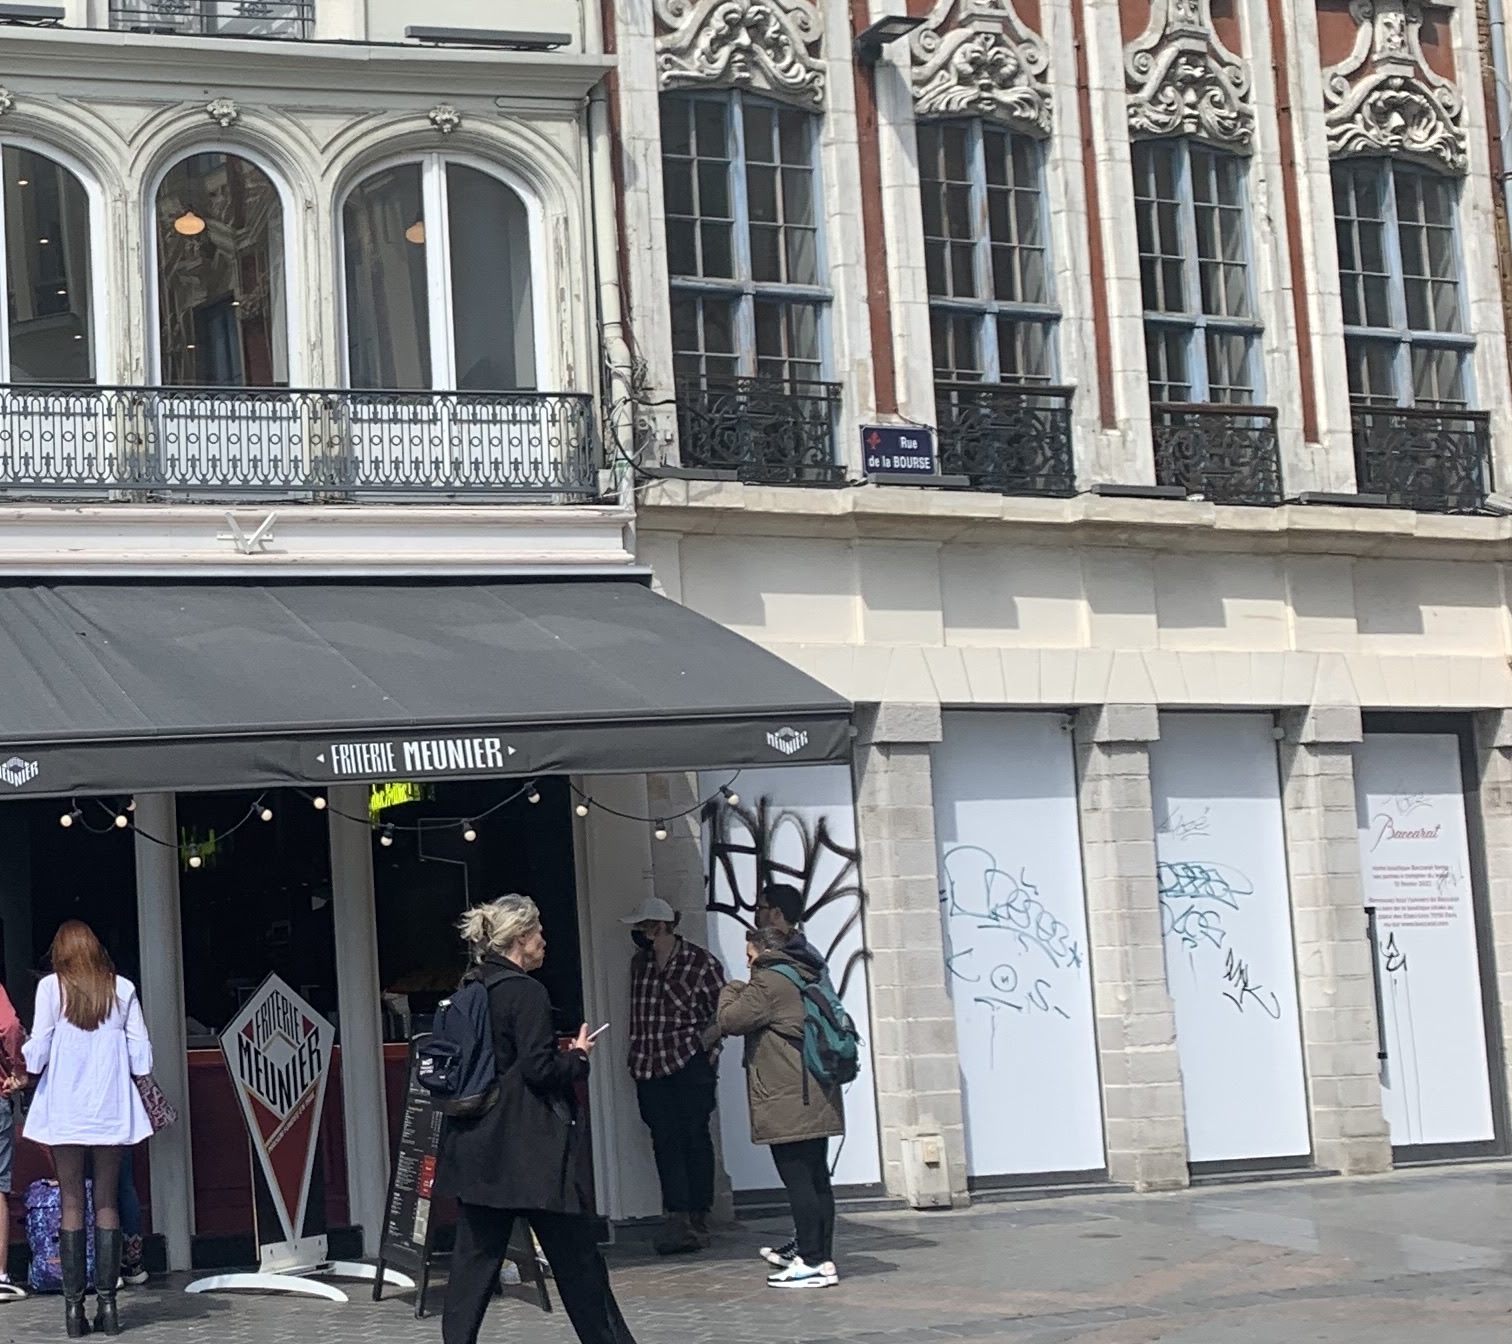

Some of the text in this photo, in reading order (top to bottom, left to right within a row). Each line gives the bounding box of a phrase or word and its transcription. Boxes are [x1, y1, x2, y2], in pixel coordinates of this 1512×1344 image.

[899, 436, 918, 449] Rue
[868, 455, 931, 470] de la BOURSE
[330, 738, 504, 774] FRITERIE MEUNIER
[1370, 813, 1442, 853] Baccarat
[255, 989, 301, 1050] FRITERIE
[237, 1025, 322, 1116] MEUNIER
